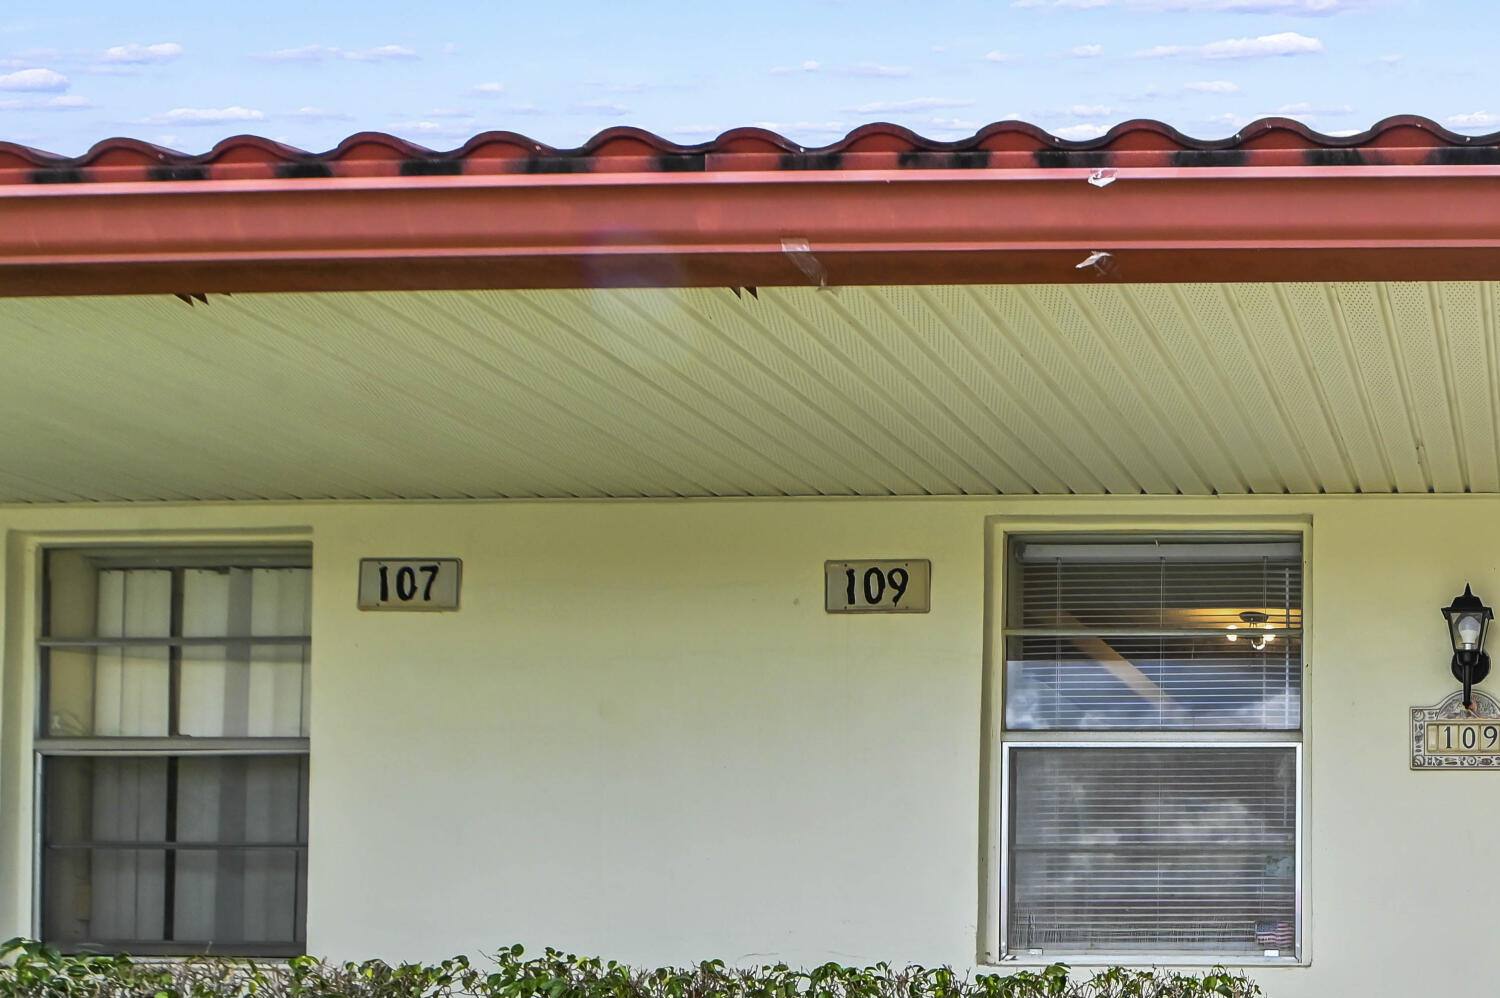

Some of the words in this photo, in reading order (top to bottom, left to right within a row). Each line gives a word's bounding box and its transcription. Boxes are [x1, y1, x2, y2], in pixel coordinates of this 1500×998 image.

[379, 565, 439, 602] 107
[846, 567, 909, 607] 109
[1443, 725, 1498, 749] 109
